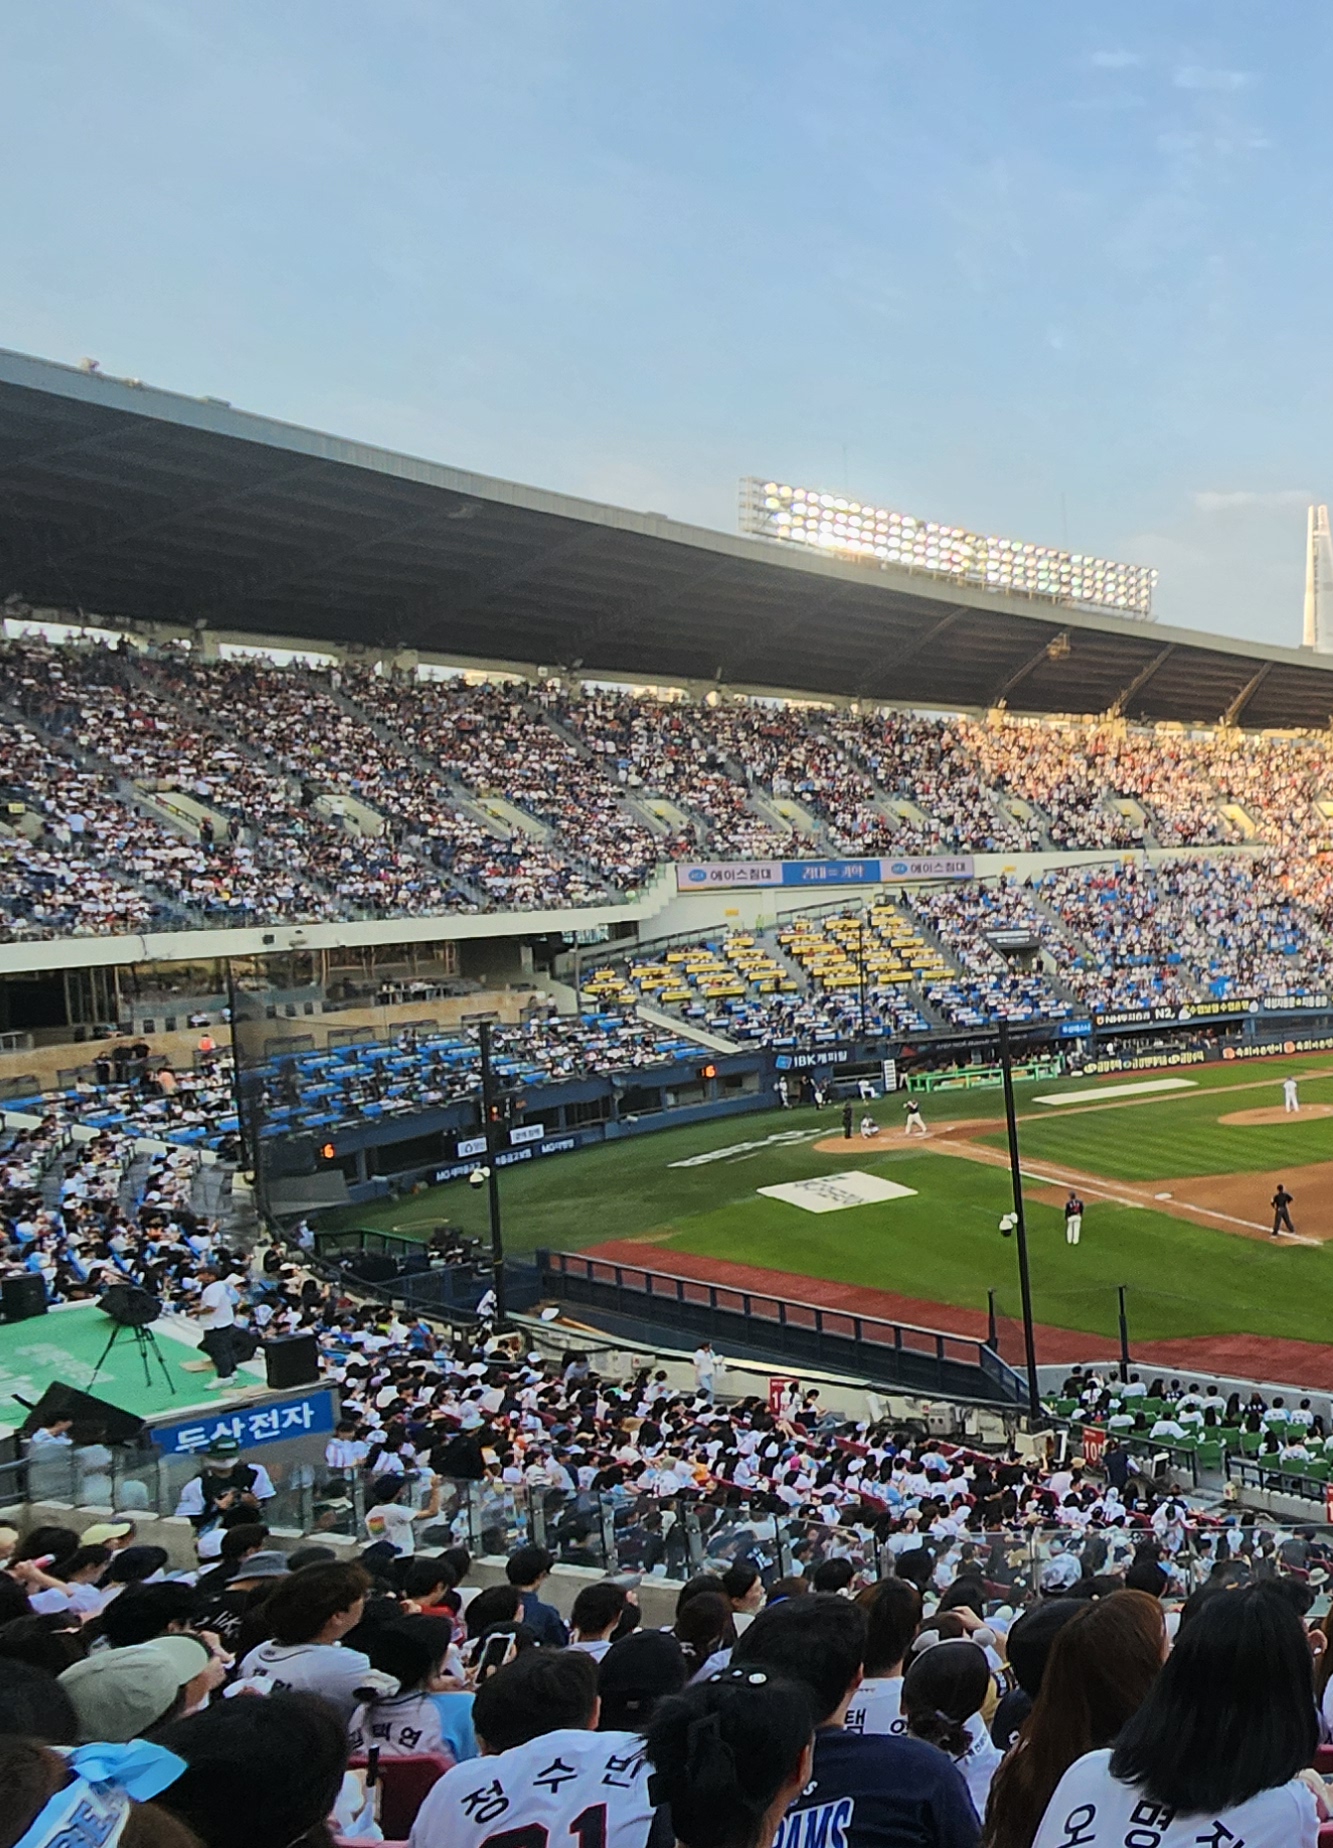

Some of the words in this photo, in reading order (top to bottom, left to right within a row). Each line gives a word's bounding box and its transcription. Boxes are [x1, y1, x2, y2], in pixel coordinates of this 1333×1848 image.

[710, 867, 772, 883] 에이스침대
[910, 861, 966, 875] 에이스침대
[461, 1755, 645, 1824] 정수빈
